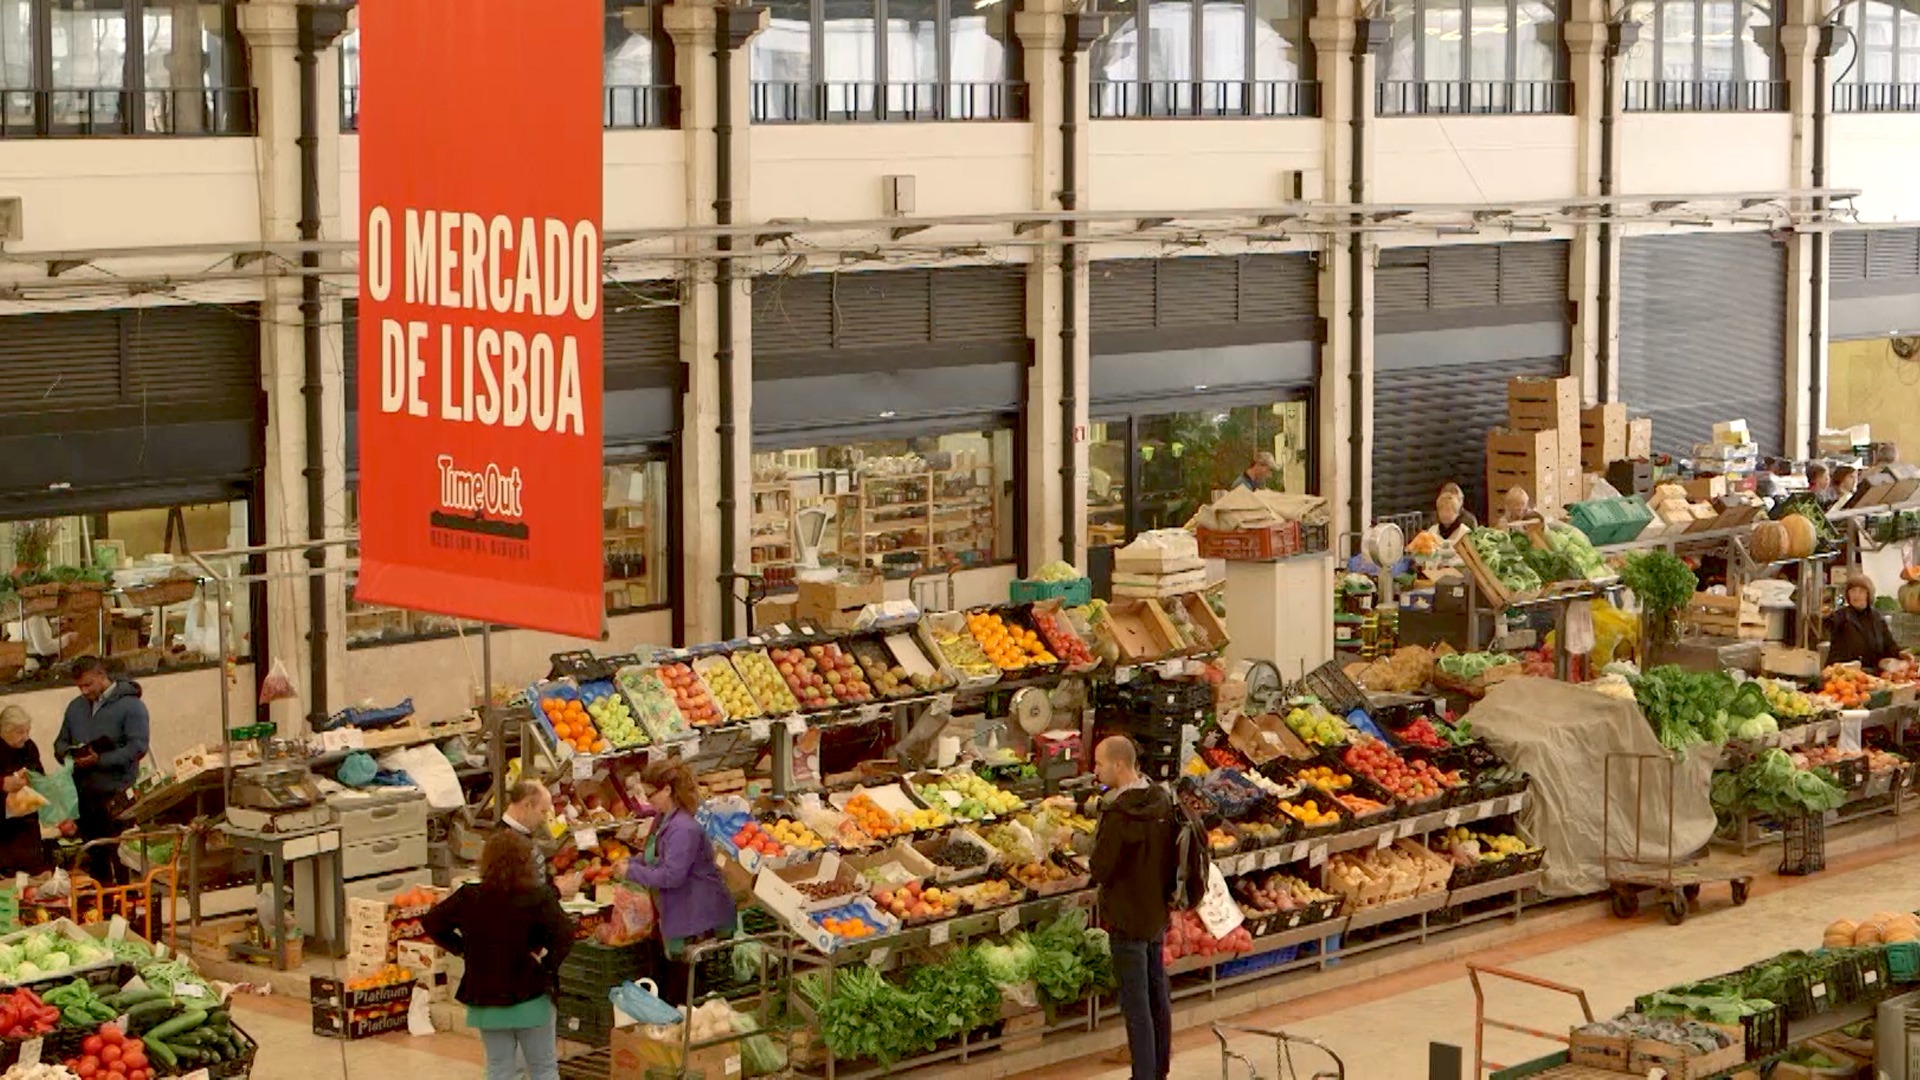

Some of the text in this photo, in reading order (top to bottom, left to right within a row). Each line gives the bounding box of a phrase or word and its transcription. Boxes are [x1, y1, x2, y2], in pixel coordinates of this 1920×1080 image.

[369, 205, 598, 319] O MERCADO
[382, 318, 585, 436] DE LISBOA
[438, 454, 523, 517] Time Out
[354, 985, 409, 1005] Platinum
